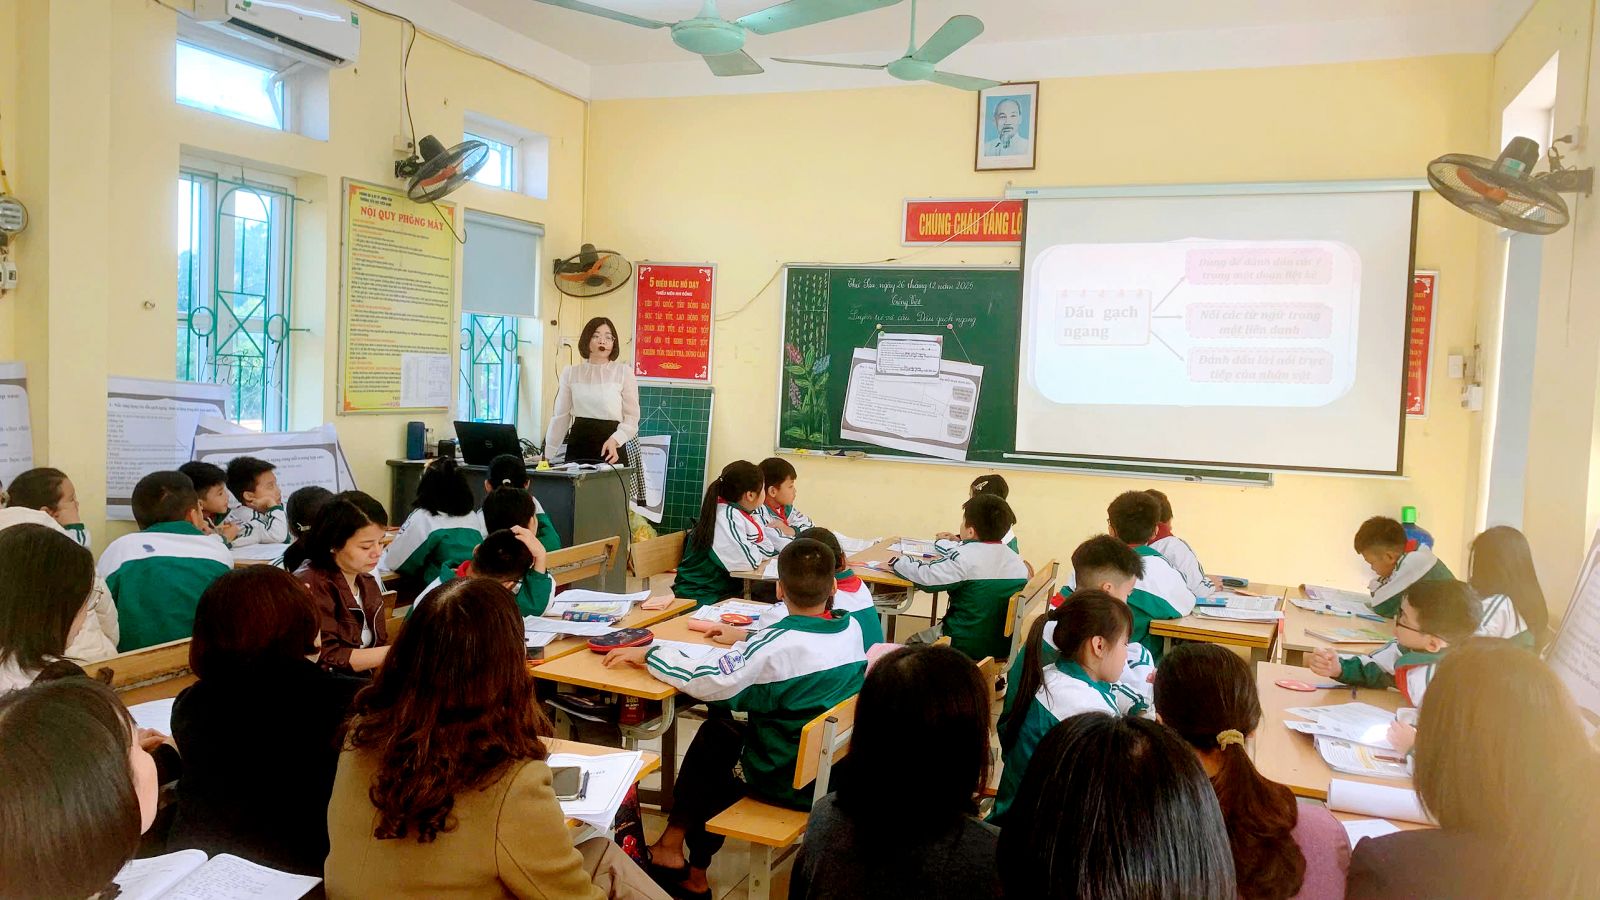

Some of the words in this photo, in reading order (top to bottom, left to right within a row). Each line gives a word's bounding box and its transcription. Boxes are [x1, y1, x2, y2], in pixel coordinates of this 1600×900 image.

[360, 204, 376, 219] NỘI
[379, 209, 397, 221] QUY
[919, 209, 951, 236] CHÚNG
[954, 208, 980, 236] CHÁU
[649, 276, 655, 288] 5
[669, 278, 680, 288] BÁC
[689, 279, 699, 289] DẠY
[1064, 304, 1095, 318] Dấu
[1103, 305, 1138, 320] gạch
[1288, 310, 1321, 322] trong
[1064, 327, 1109, 340] ngang
[1270, 325, 1300, 335] danh
